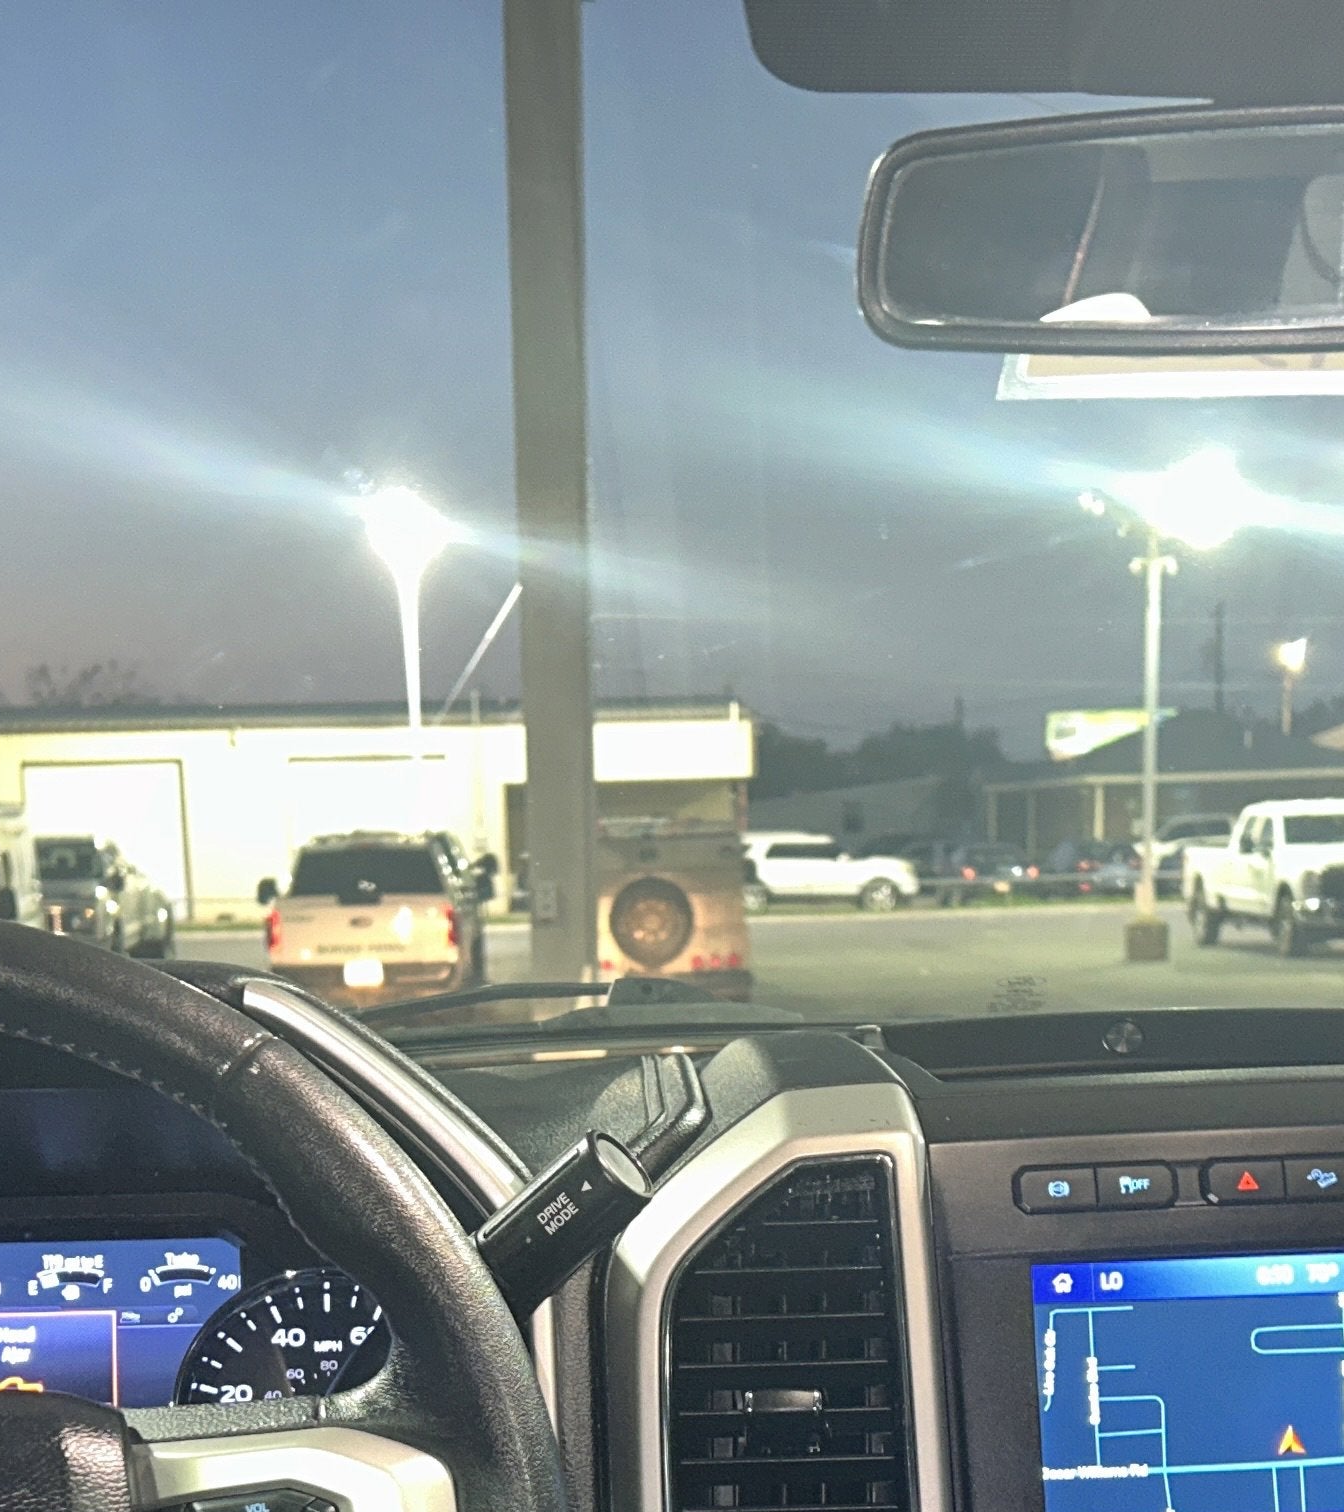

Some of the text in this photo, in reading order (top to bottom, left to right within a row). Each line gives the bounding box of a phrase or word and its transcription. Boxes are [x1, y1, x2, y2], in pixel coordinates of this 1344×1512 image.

[1132, 1178, 1150, 1190] OFF
[537, 1191, 570, 1225] DRIVE
[544, 1201, 579, 1236] MODE
[27, 1279, 39, 1296] E
[102, 1277, 113, 1293] F
[218, 1274, 238, 1290] 40
[1100, 1271, 1124, 1294] LO
[271, 1327, 306, 1347] 40
[313, 1339, 343, 1353] MPH
[320, 1360, 338, 1371] 80
[286, 1368, 305, 1380] 60
[220, 1384, 253, 1404] 20
